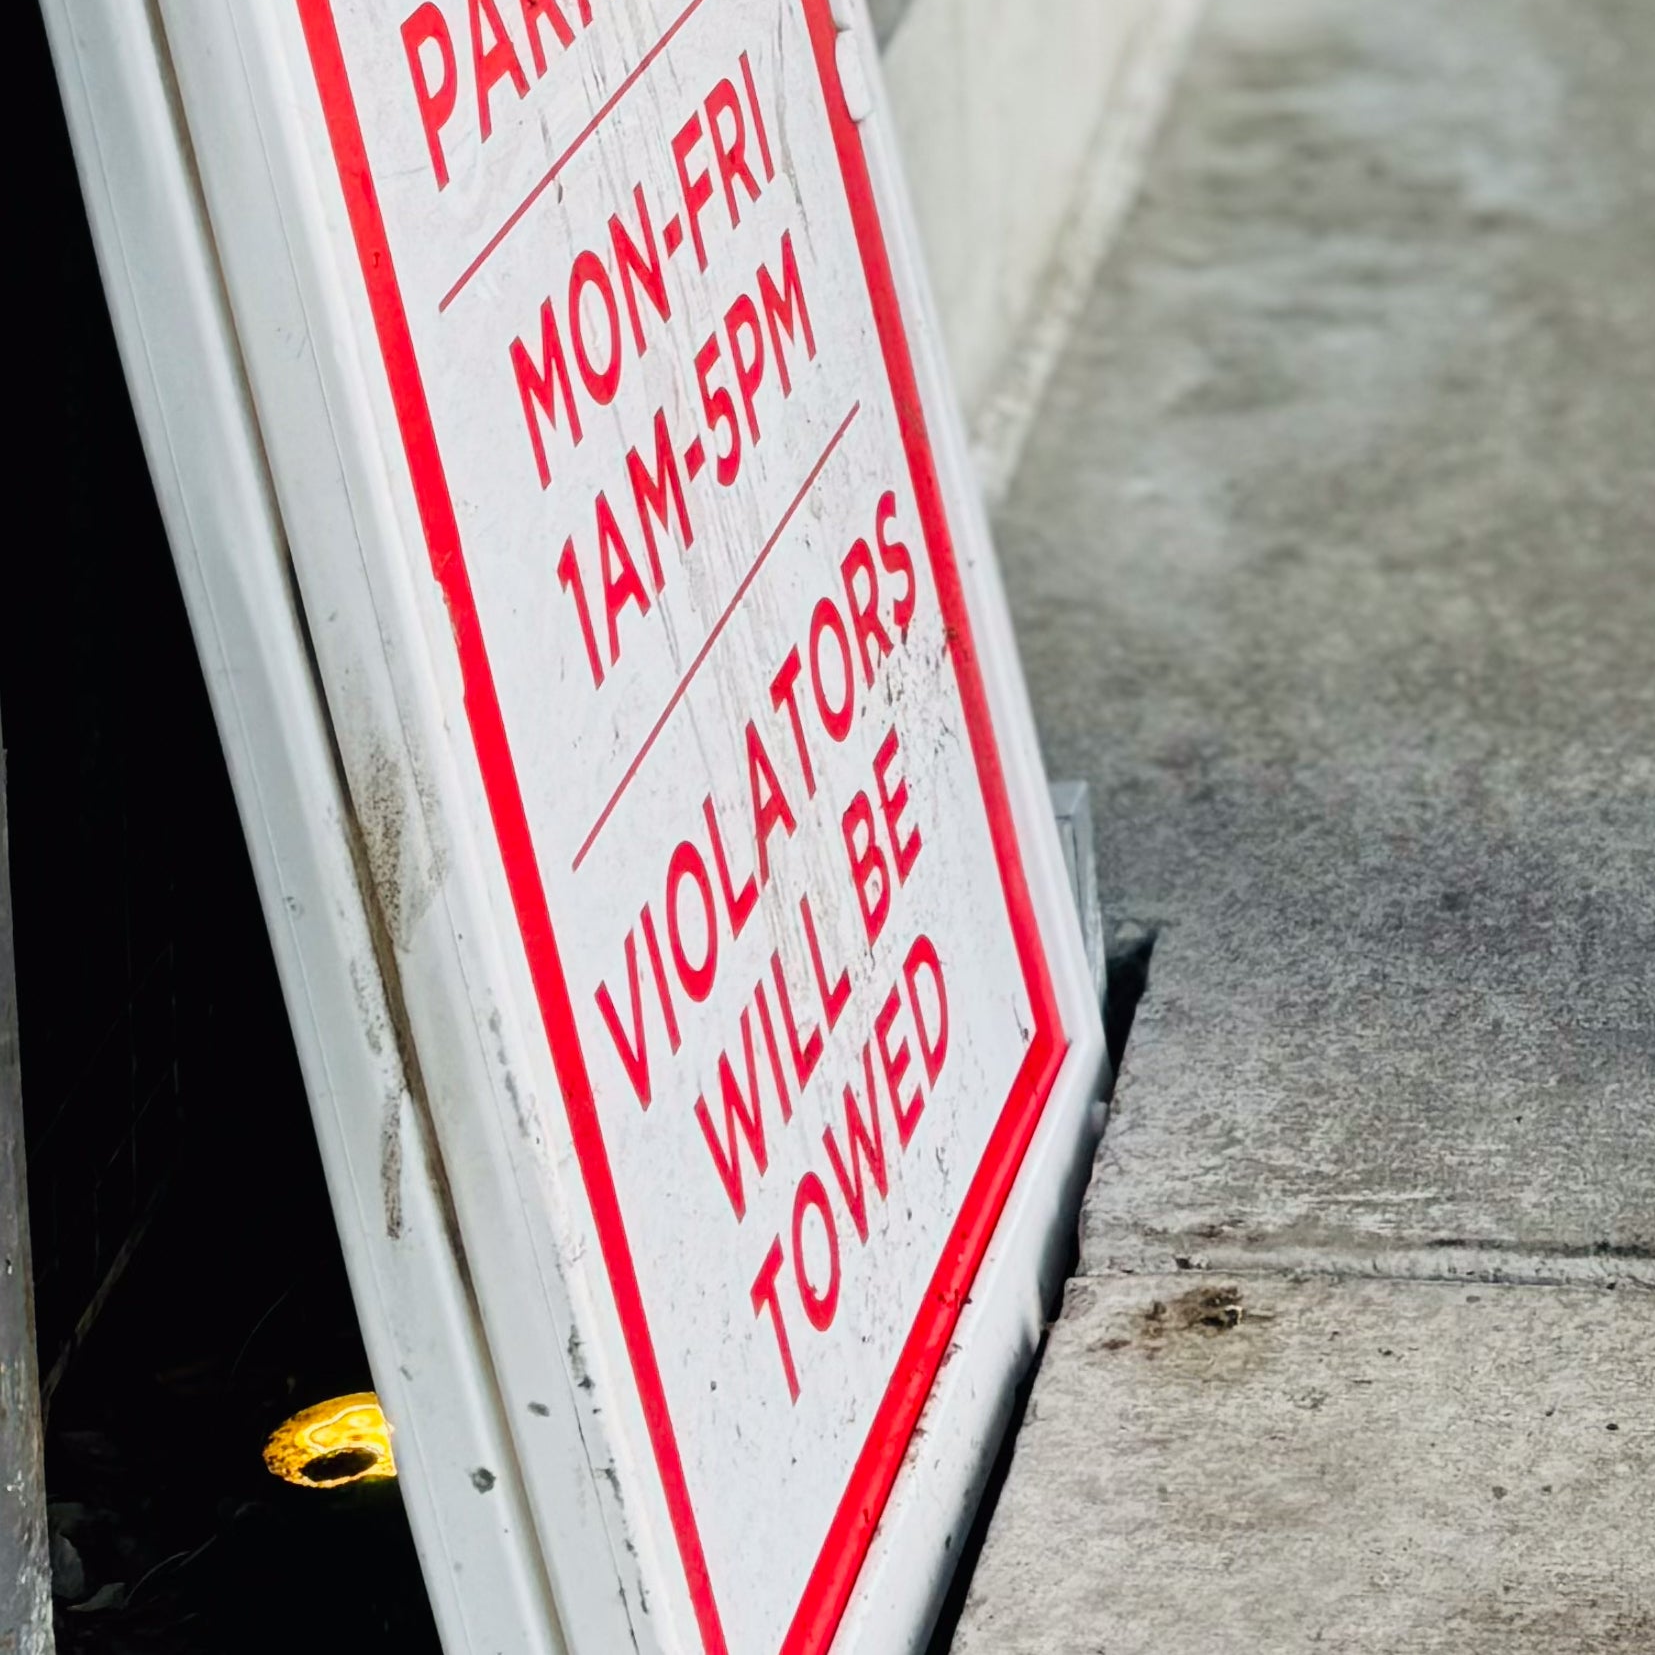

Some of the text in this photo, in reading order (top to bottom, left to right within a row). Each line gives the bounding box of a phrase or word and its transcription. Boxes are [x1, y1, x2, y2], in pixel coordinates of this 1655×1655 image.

[509, 50, 775, 491] MON-FRI
[557, 229, 817, 690] 1AM-5PM
[594, 491, 918, 1111] VIOLATORS
[694, 727, 923, 1223] WILL BE
[749, 934, 949, 1404] TOWED
